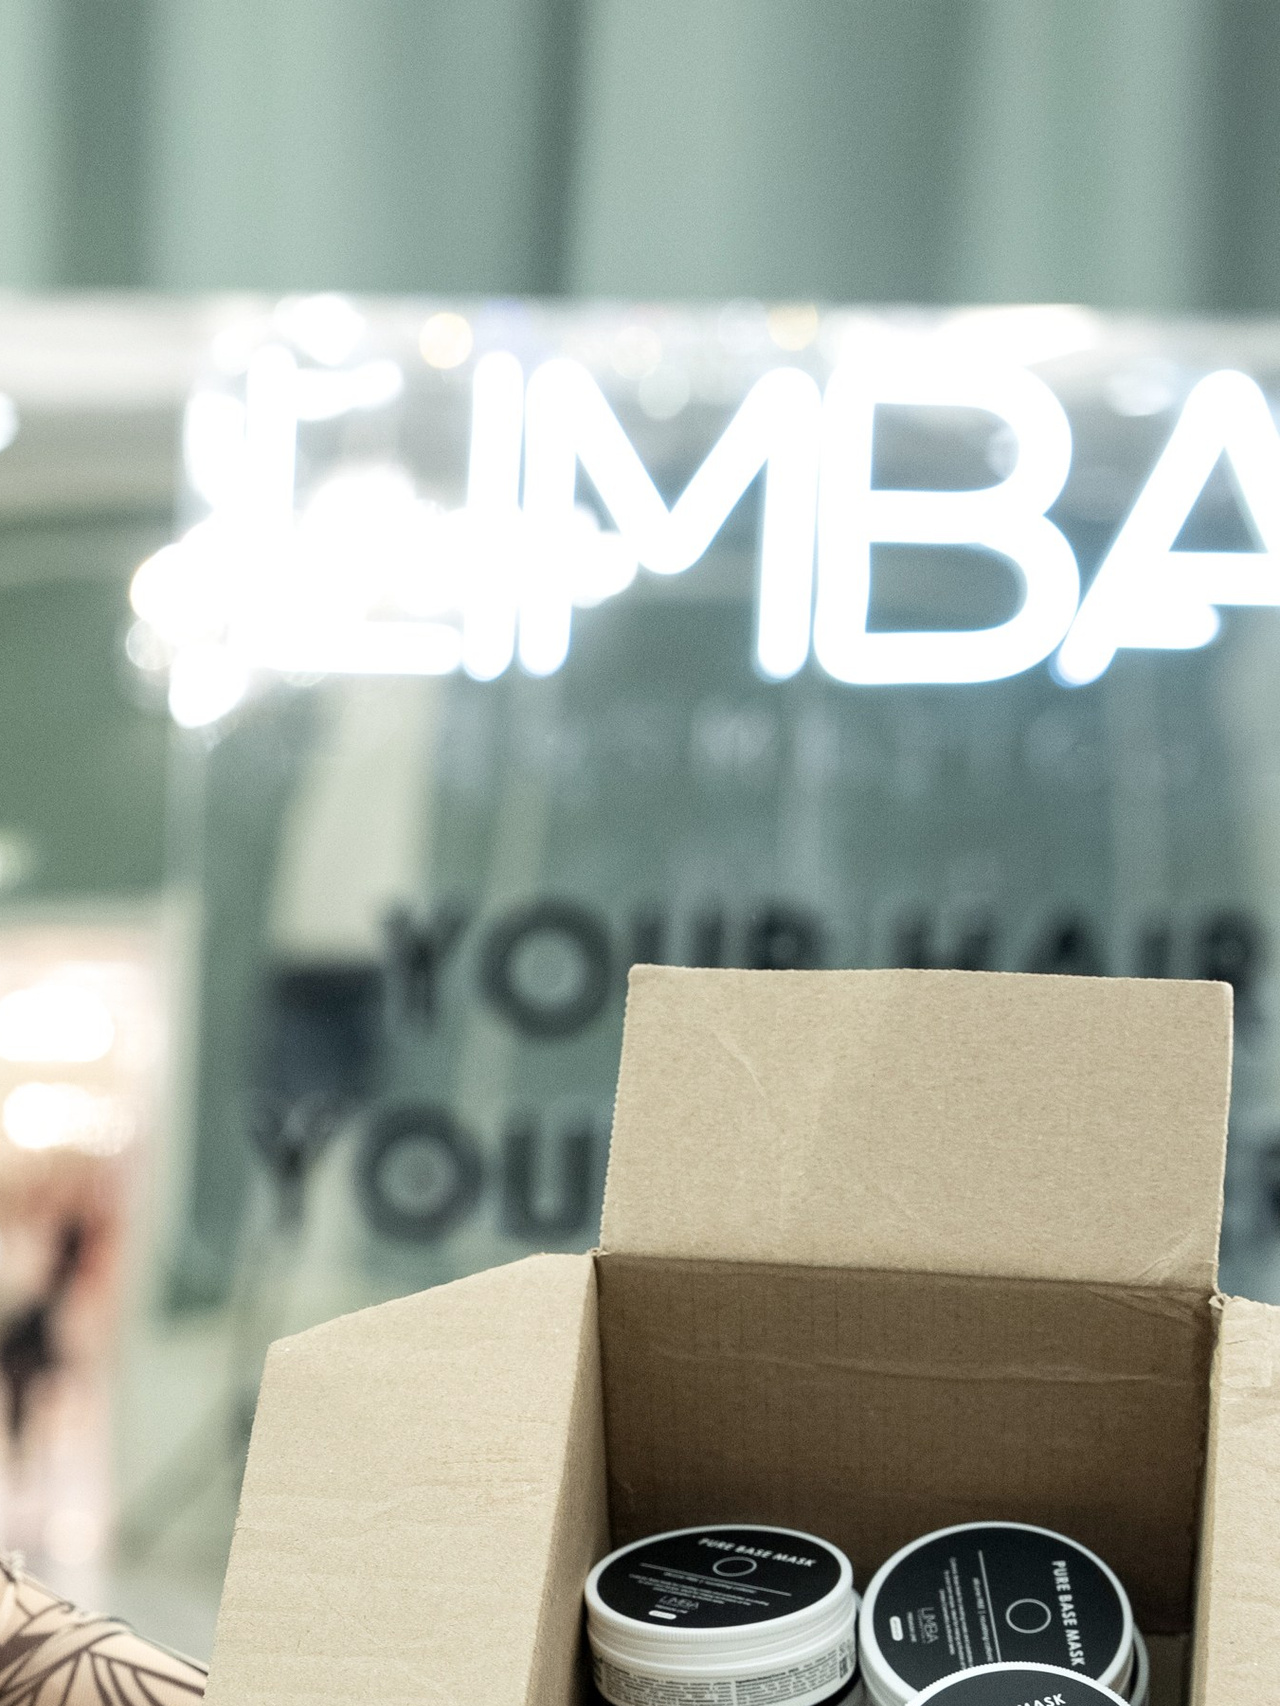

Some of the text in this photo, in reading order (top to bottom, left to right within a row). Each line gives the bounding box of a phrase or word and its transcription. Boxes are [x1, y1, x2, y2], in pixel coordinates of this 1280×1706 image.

[228, 345, 1280, 688] LIMBA
[698, 1538, 816, 1567] PURE BASE MASK
[1052, 1560, 1085, 1667] PURE BASE MASK
